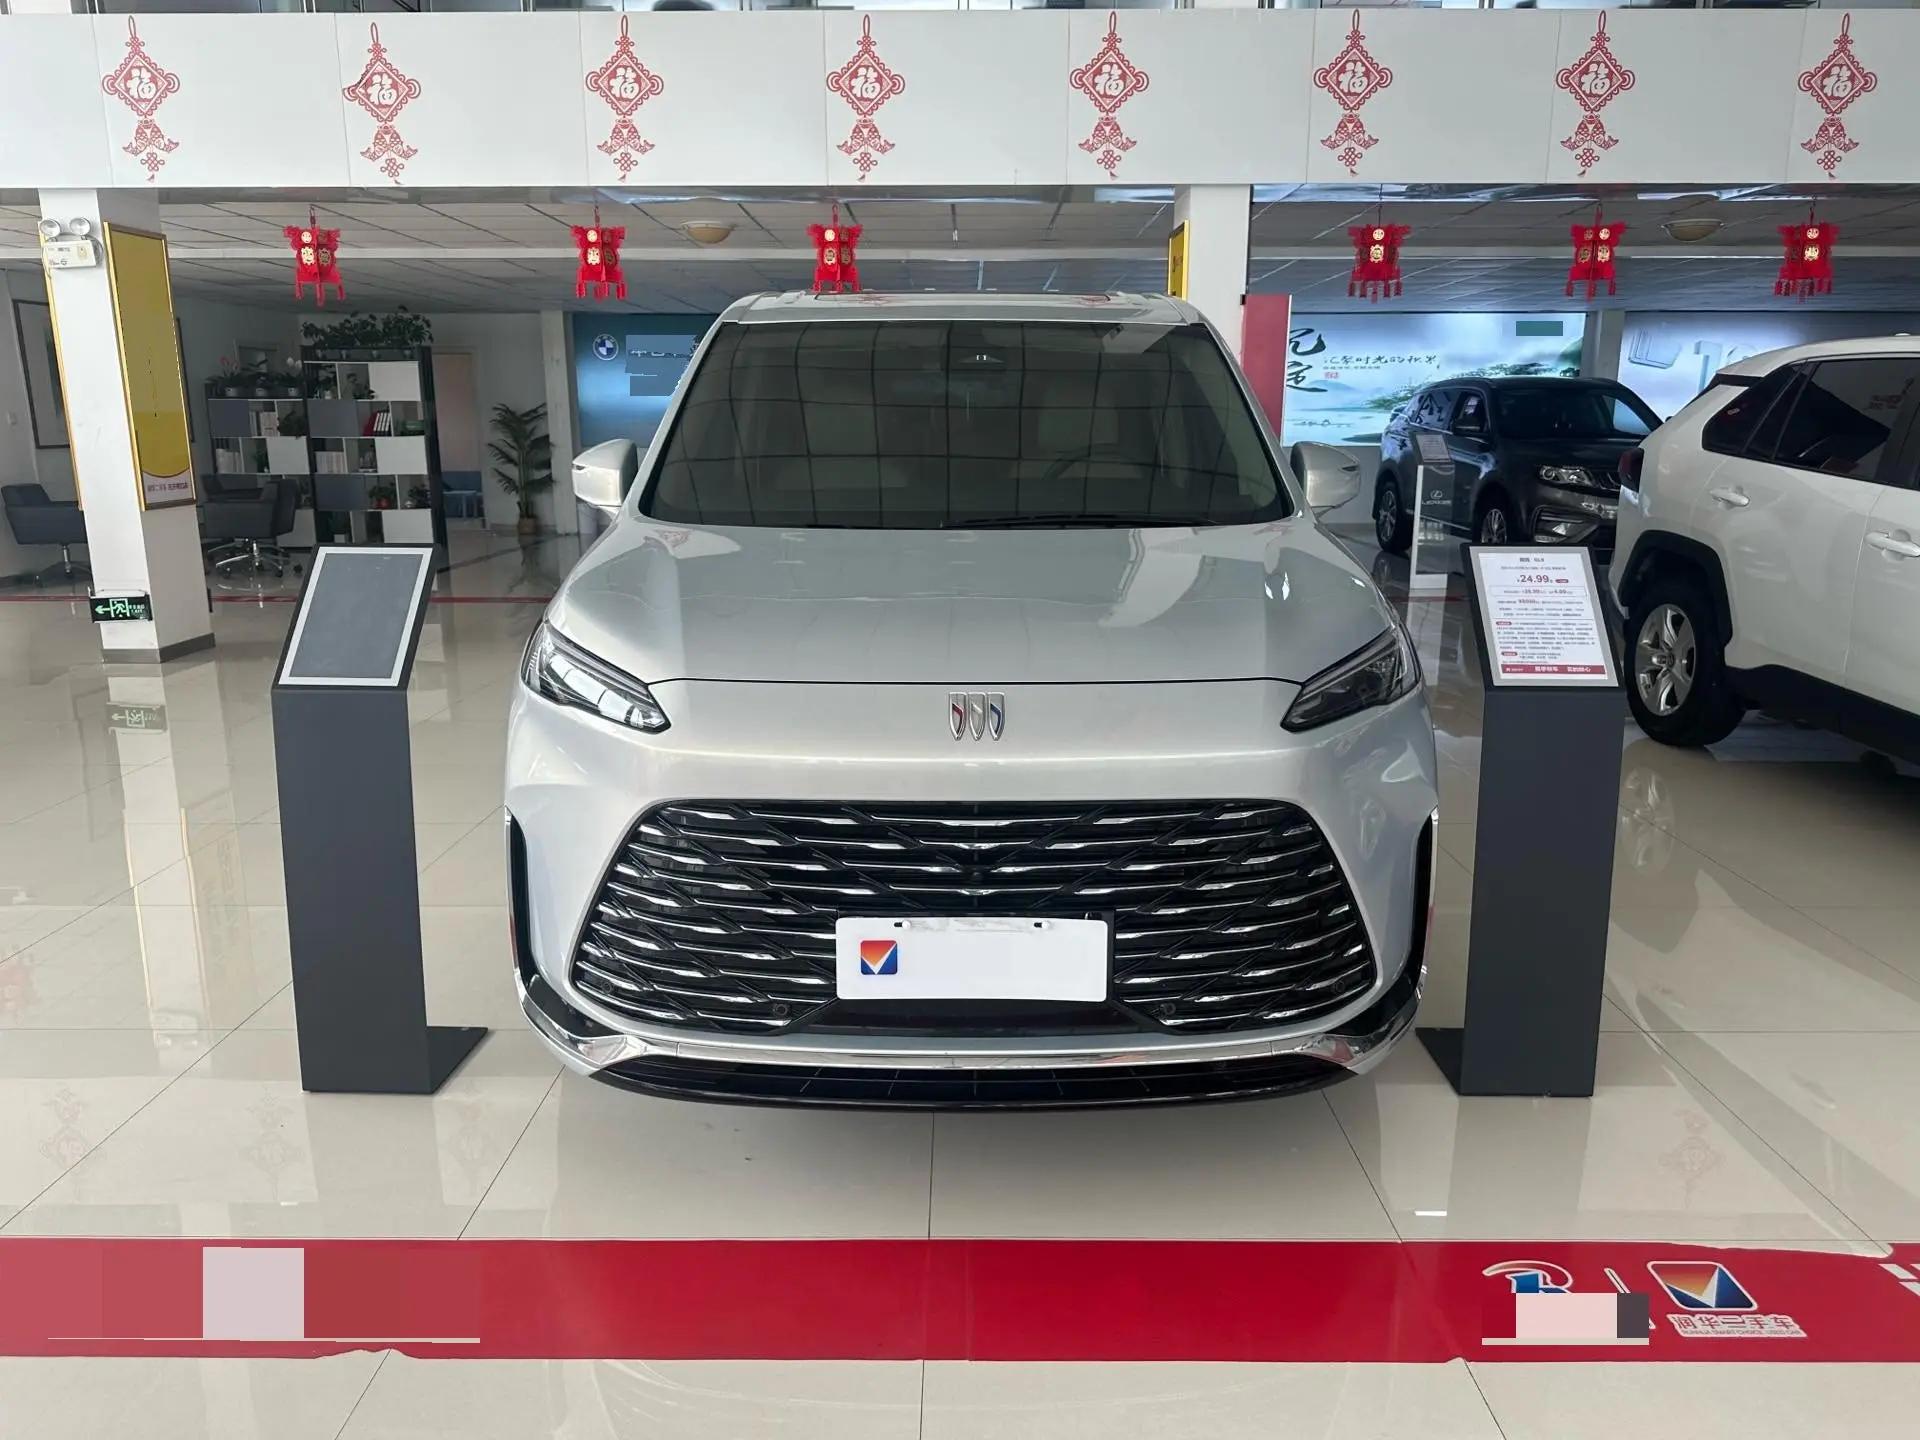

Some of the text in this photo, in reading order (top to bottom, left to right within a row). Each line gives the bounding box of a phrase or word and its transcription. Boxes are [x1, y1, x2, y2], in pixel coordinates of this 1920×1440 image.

[126, 67, 156, 100] 福
[366, 71, 396, 105] 福
[609, 67, 640, 99] 福
[850, 67, 881, 99] 福
[1093, 67, 1124, 99] 福
[1337, 67, 1367, 99] 福
[1580, 67, 1611, 99] 福
[1821, 66, 1852, 98] 福
[1671, 1315, 1794, 1330] 润华二手车
